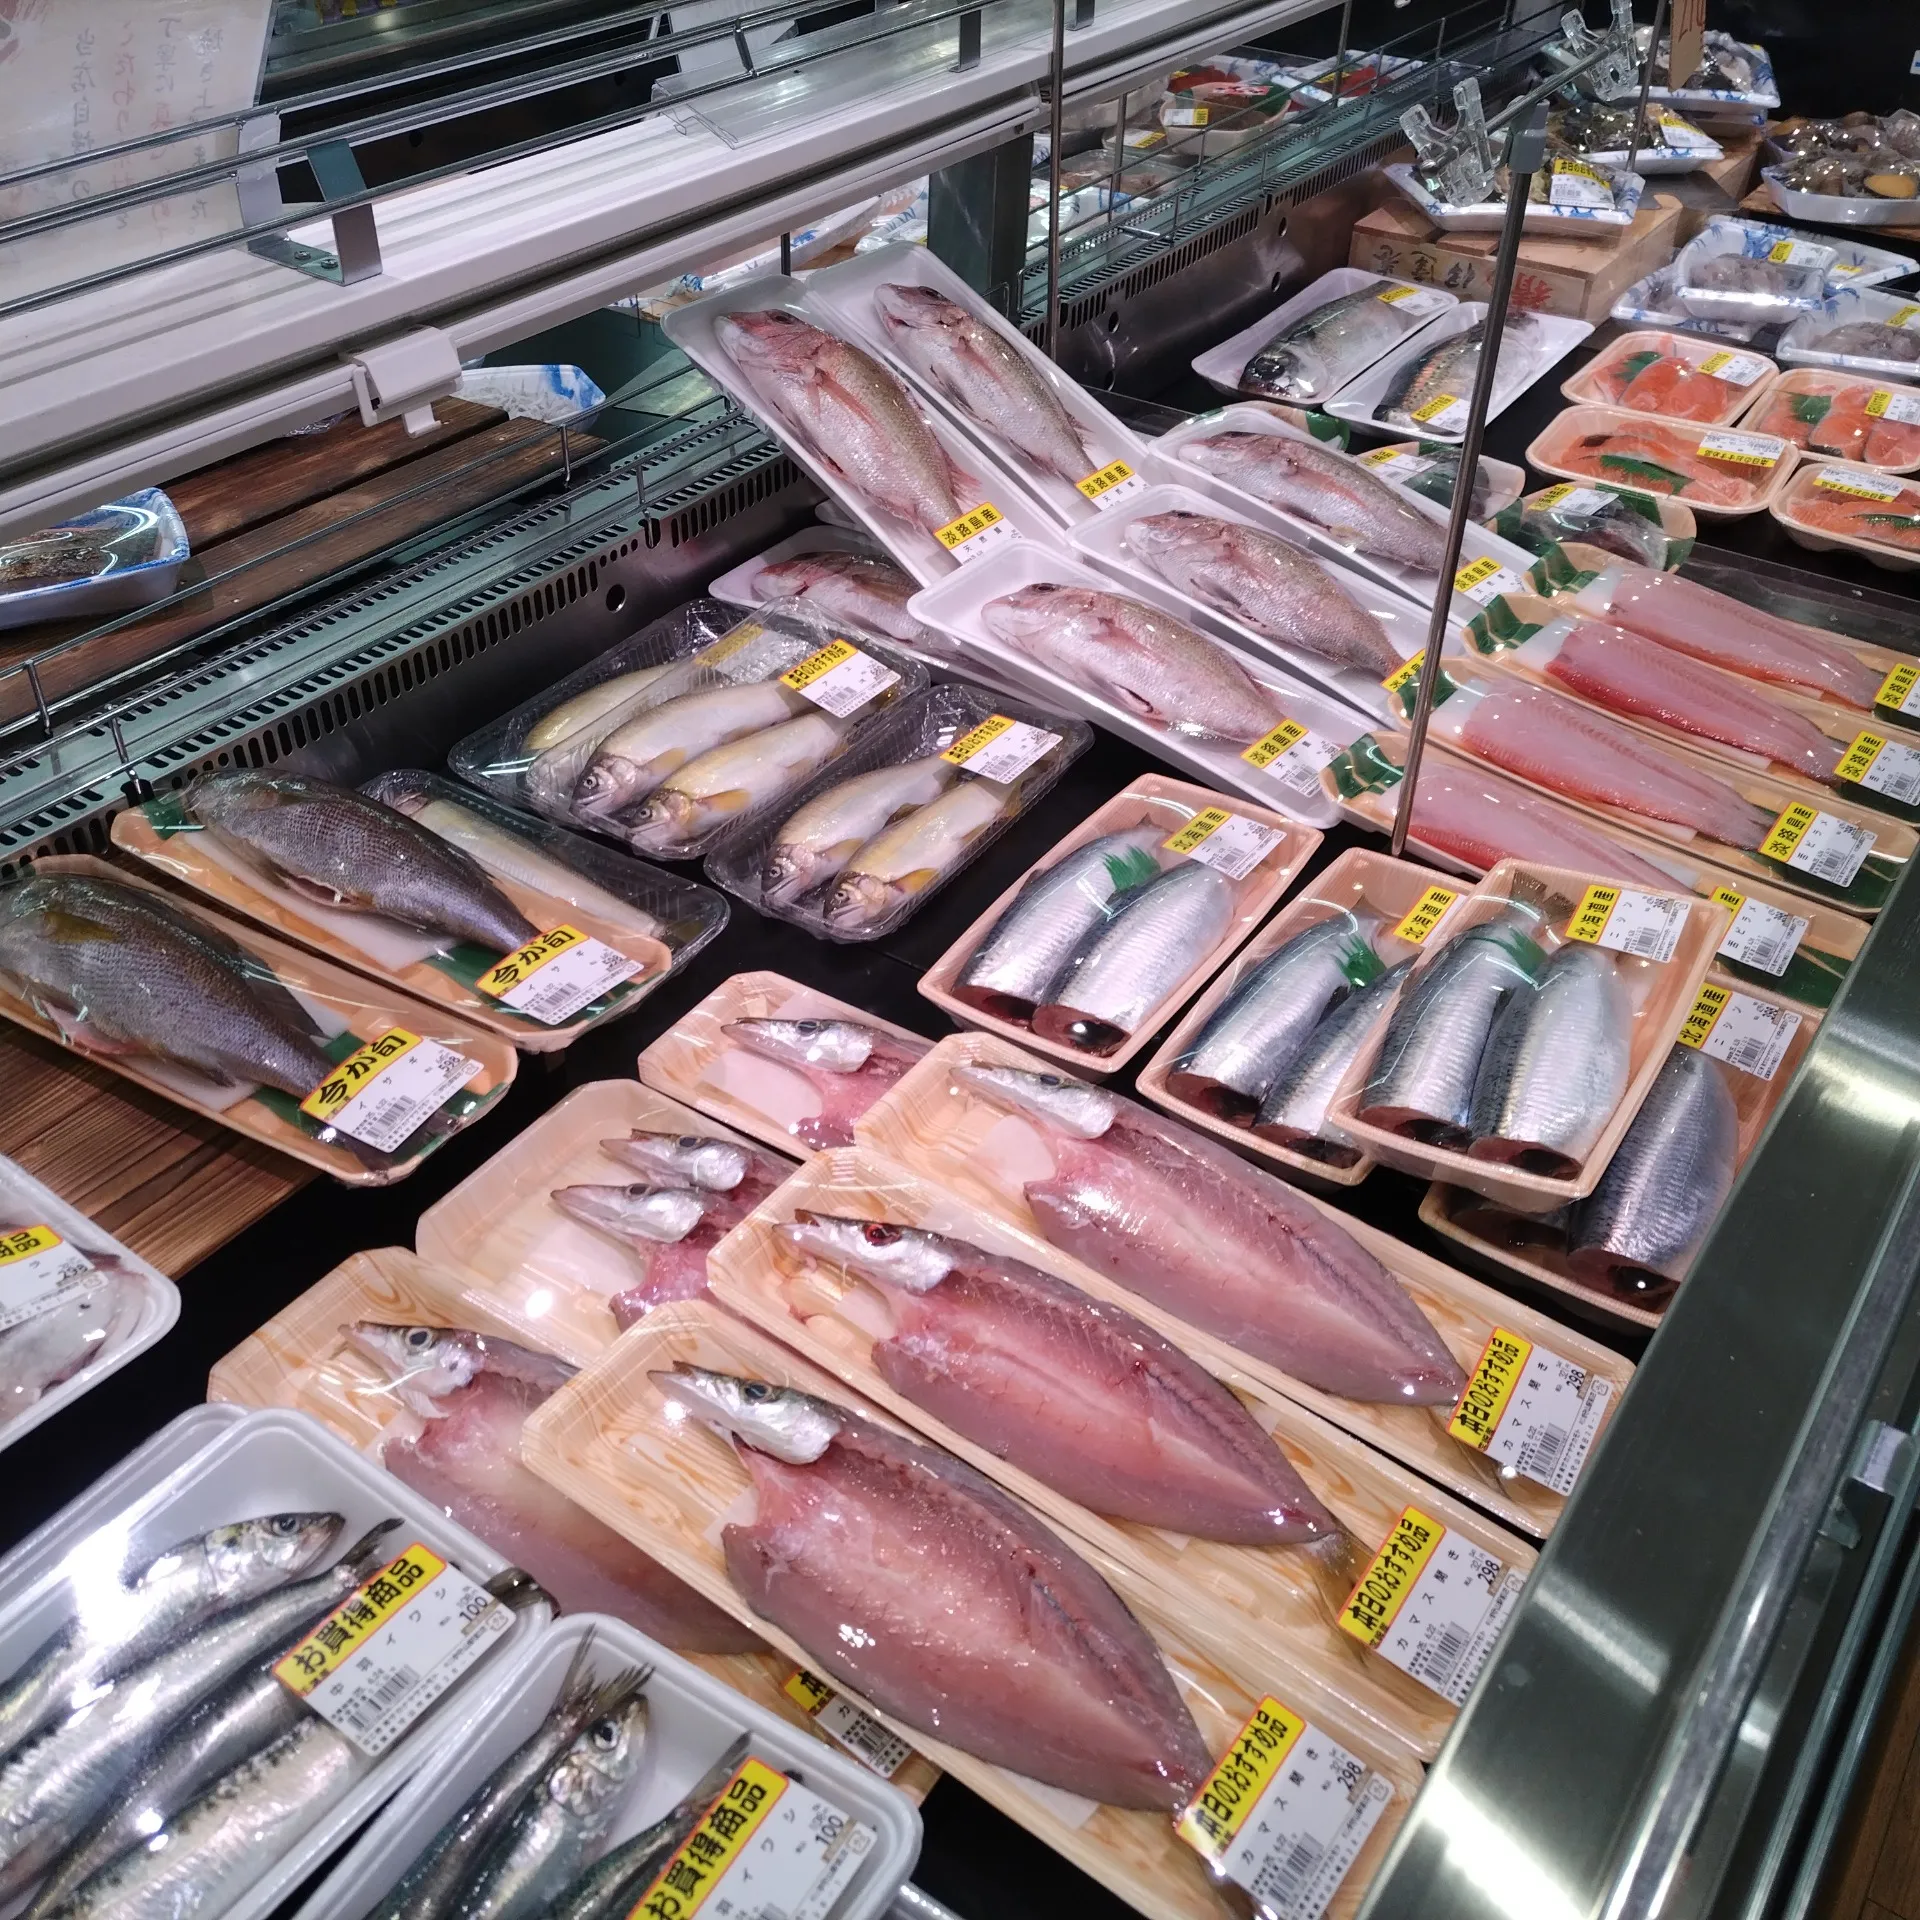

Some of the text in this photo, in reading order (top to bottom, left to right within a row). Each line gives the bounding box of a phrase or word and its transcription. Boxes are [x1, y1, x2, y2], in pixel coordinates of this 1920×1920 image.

[941, 507, 997, 545] 淡路島産
[488, 926, 575, 985] 今が旬
[313, 1031, 407, 1104] 今が旬
[438, 1055, 460, 1072] 598
[1454, 1337, 1520, 1435] 本日のおすすめ品
[1501, 1362, 1548, 1450] カマス開き
[1565, 1368, 1584, 1390] 298
[458, 1594, 488, 1623] 100
[1345, 1518, 1431, 1631] 本日のおすすめ品
[1395, 1550, 1459, 1650] カマス開き
[1476, 1559, 1501, 1585] 298
[290, 1556, 425, 1677] お買得商品
[1189, 1709, 1289, 1839] 本日のおすすめ品
[1238, 1747, 1319, 1865] カマス開き
[1335, 1760, 1363, 1791] 298
[644, 1777, 767, 1920] お買得商品
[813, 1814, 844, 1847] 100
